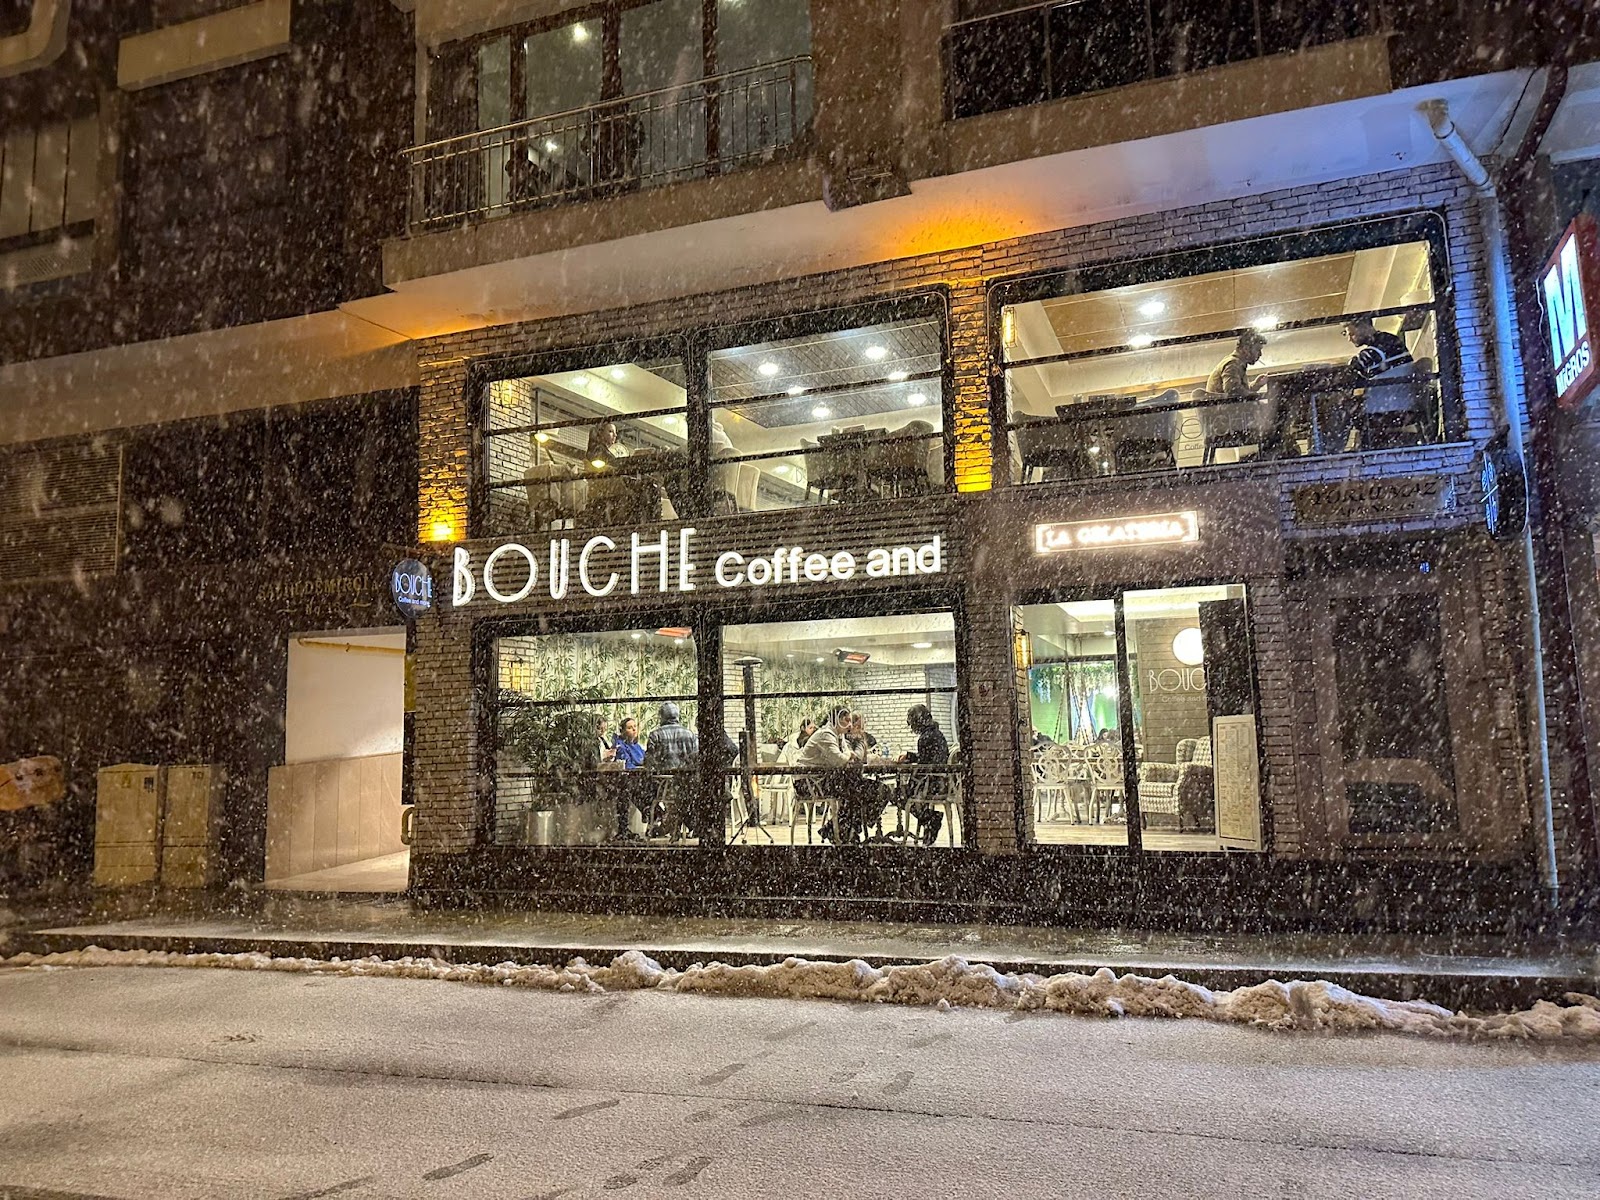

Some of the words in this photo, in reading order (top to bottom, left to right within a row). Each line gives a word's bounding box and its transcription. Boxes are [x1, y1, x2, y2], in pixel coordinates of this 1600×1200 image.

[1045, 530, 1072, 547] LA
[452, 527, 697, 607] BOUCHE
[714, 546, 857, 588] Coffee
[865, 535, 941, 578] and
[395, 572, 432, 598] BOUCHE
